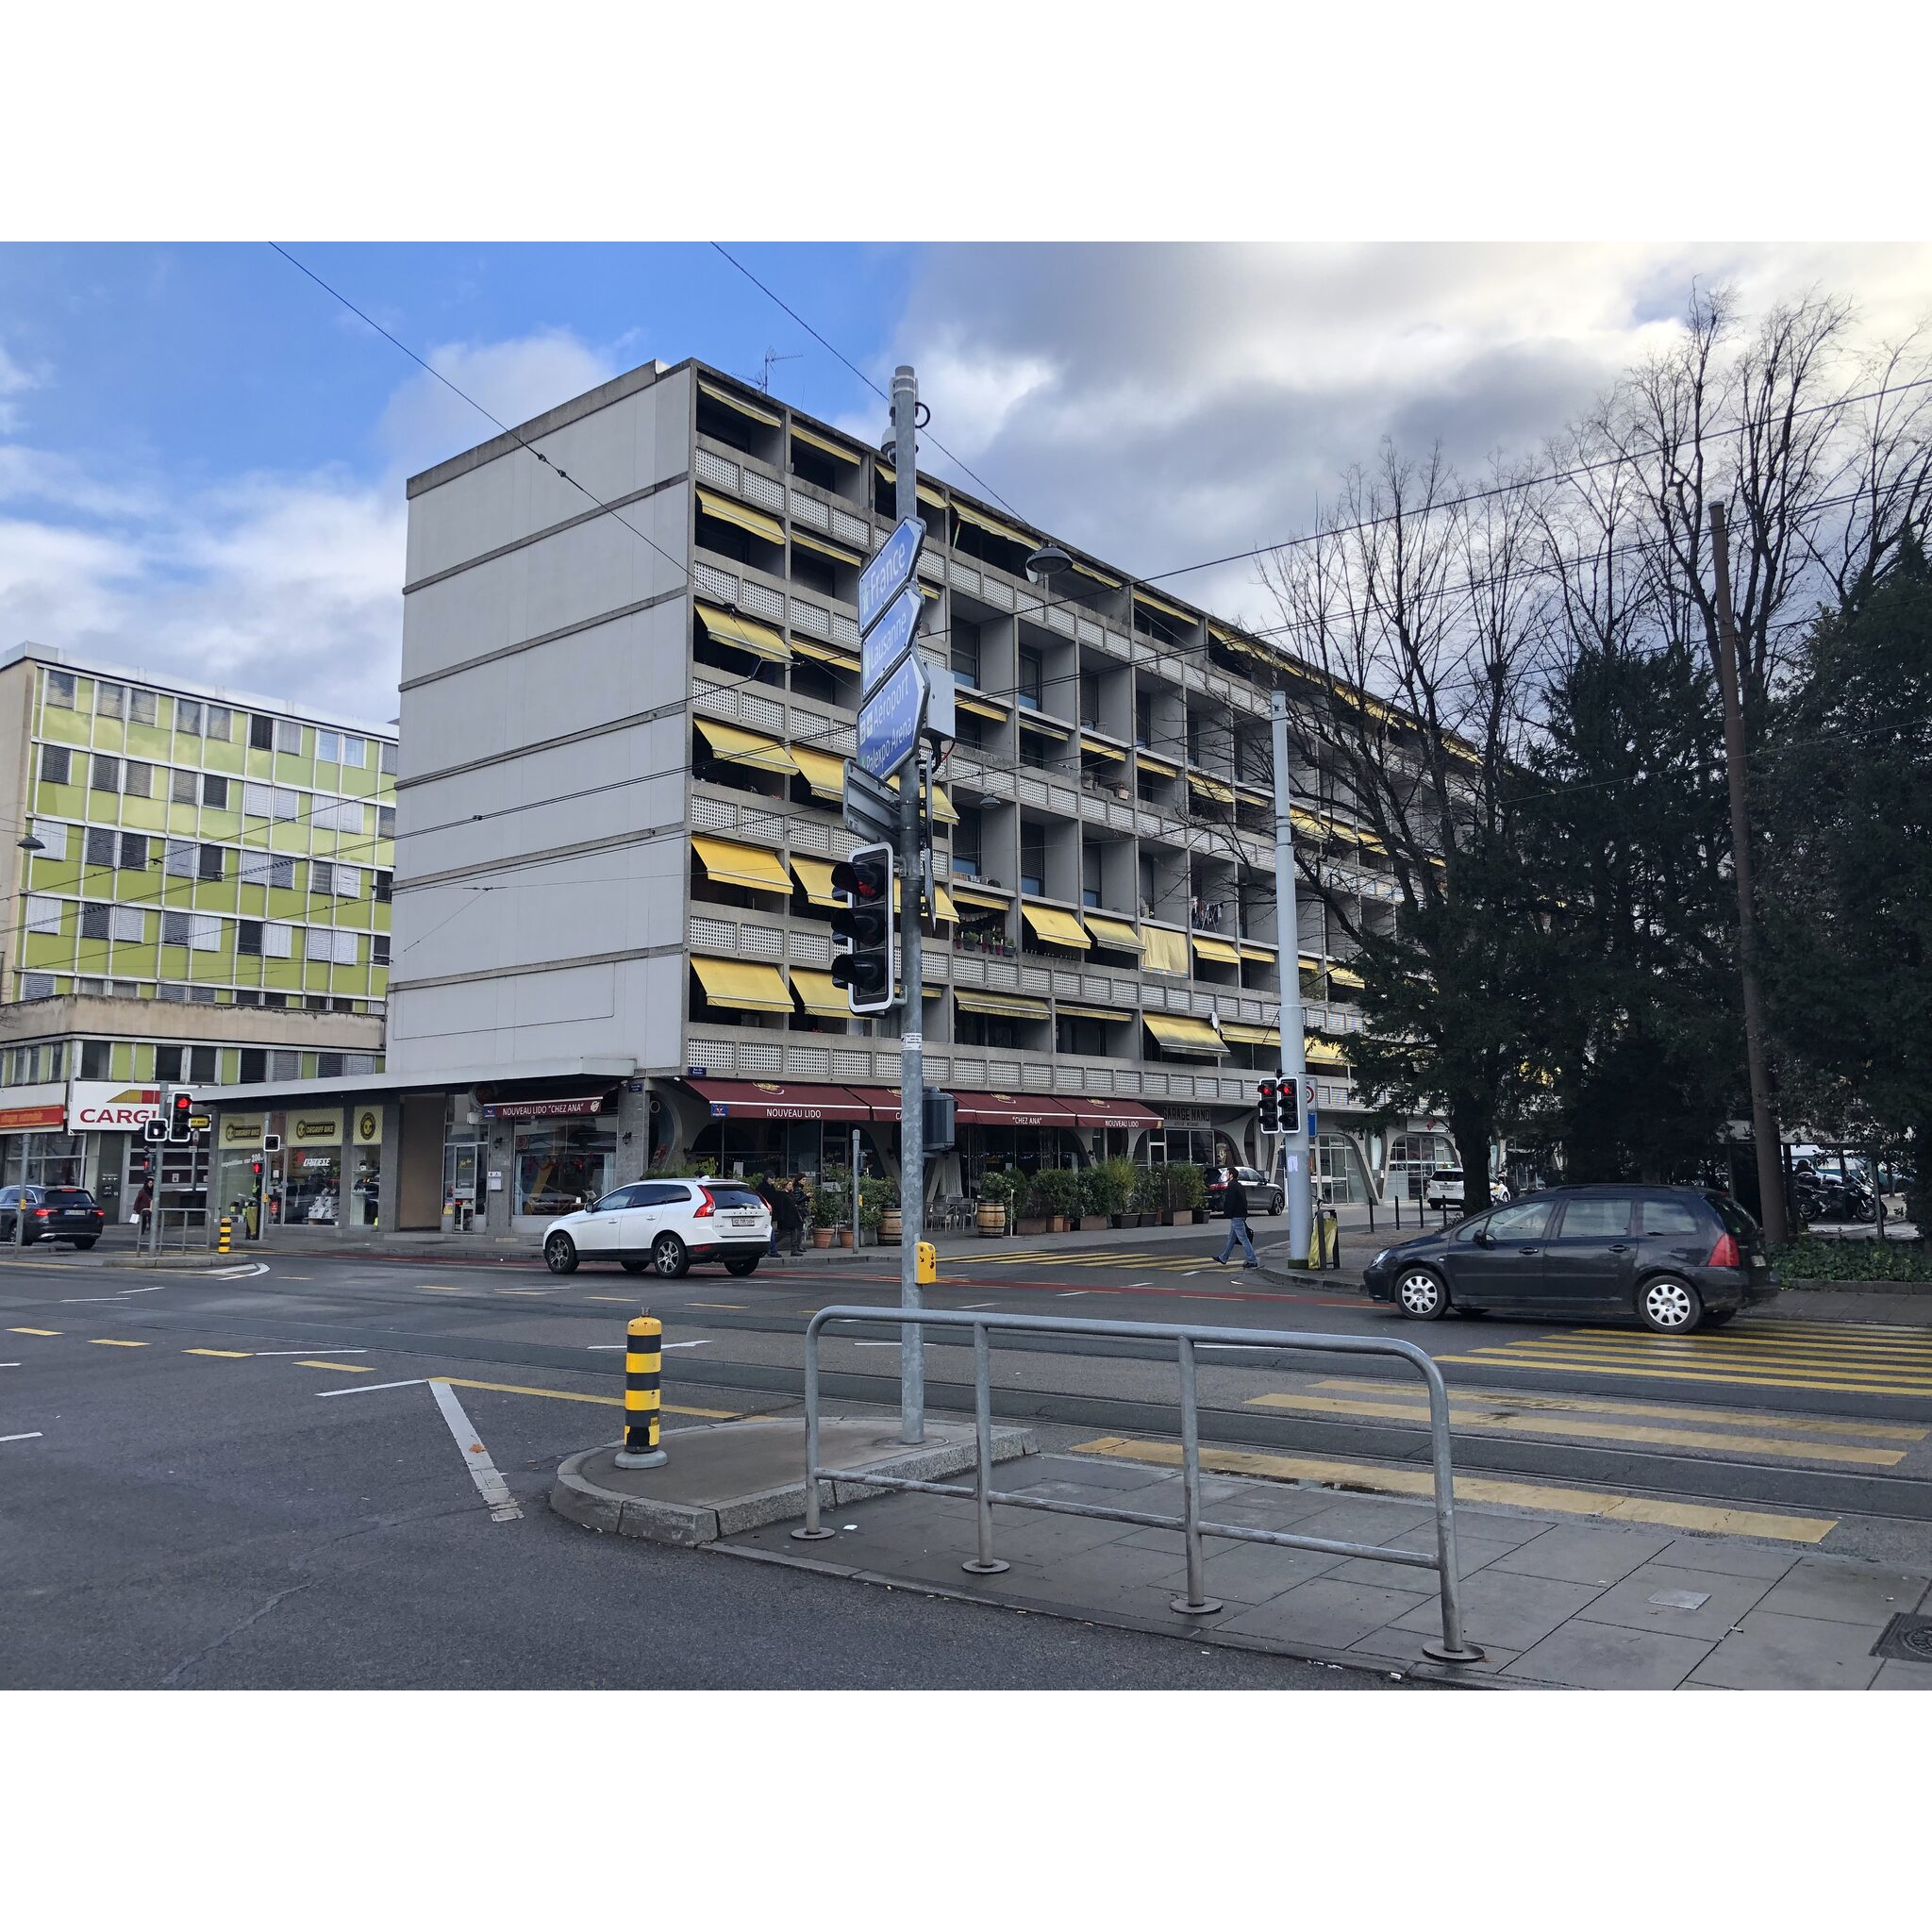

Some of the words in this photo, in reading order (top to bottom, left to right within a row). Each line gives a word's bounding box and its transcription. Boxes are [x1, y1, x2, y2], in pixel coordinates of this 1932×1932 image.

[870, 541, 906, 602] France
[871, 612, 907, 666] Lausanne
[873, 675, 909, 728] Aéroport
[865, 741, 891, 774] Palexpo
[891, 722, 912, 750] Arena
[503, 1106, 532, 1116] NOUVEAU
[533, 1105, 547, 1114] LIDO
[766, 1108, 803, 1118] NOUVEAU
[804, 1109, 822, 1119] LIDO
[1162, 1107, 1190, 1121] GARAGE
